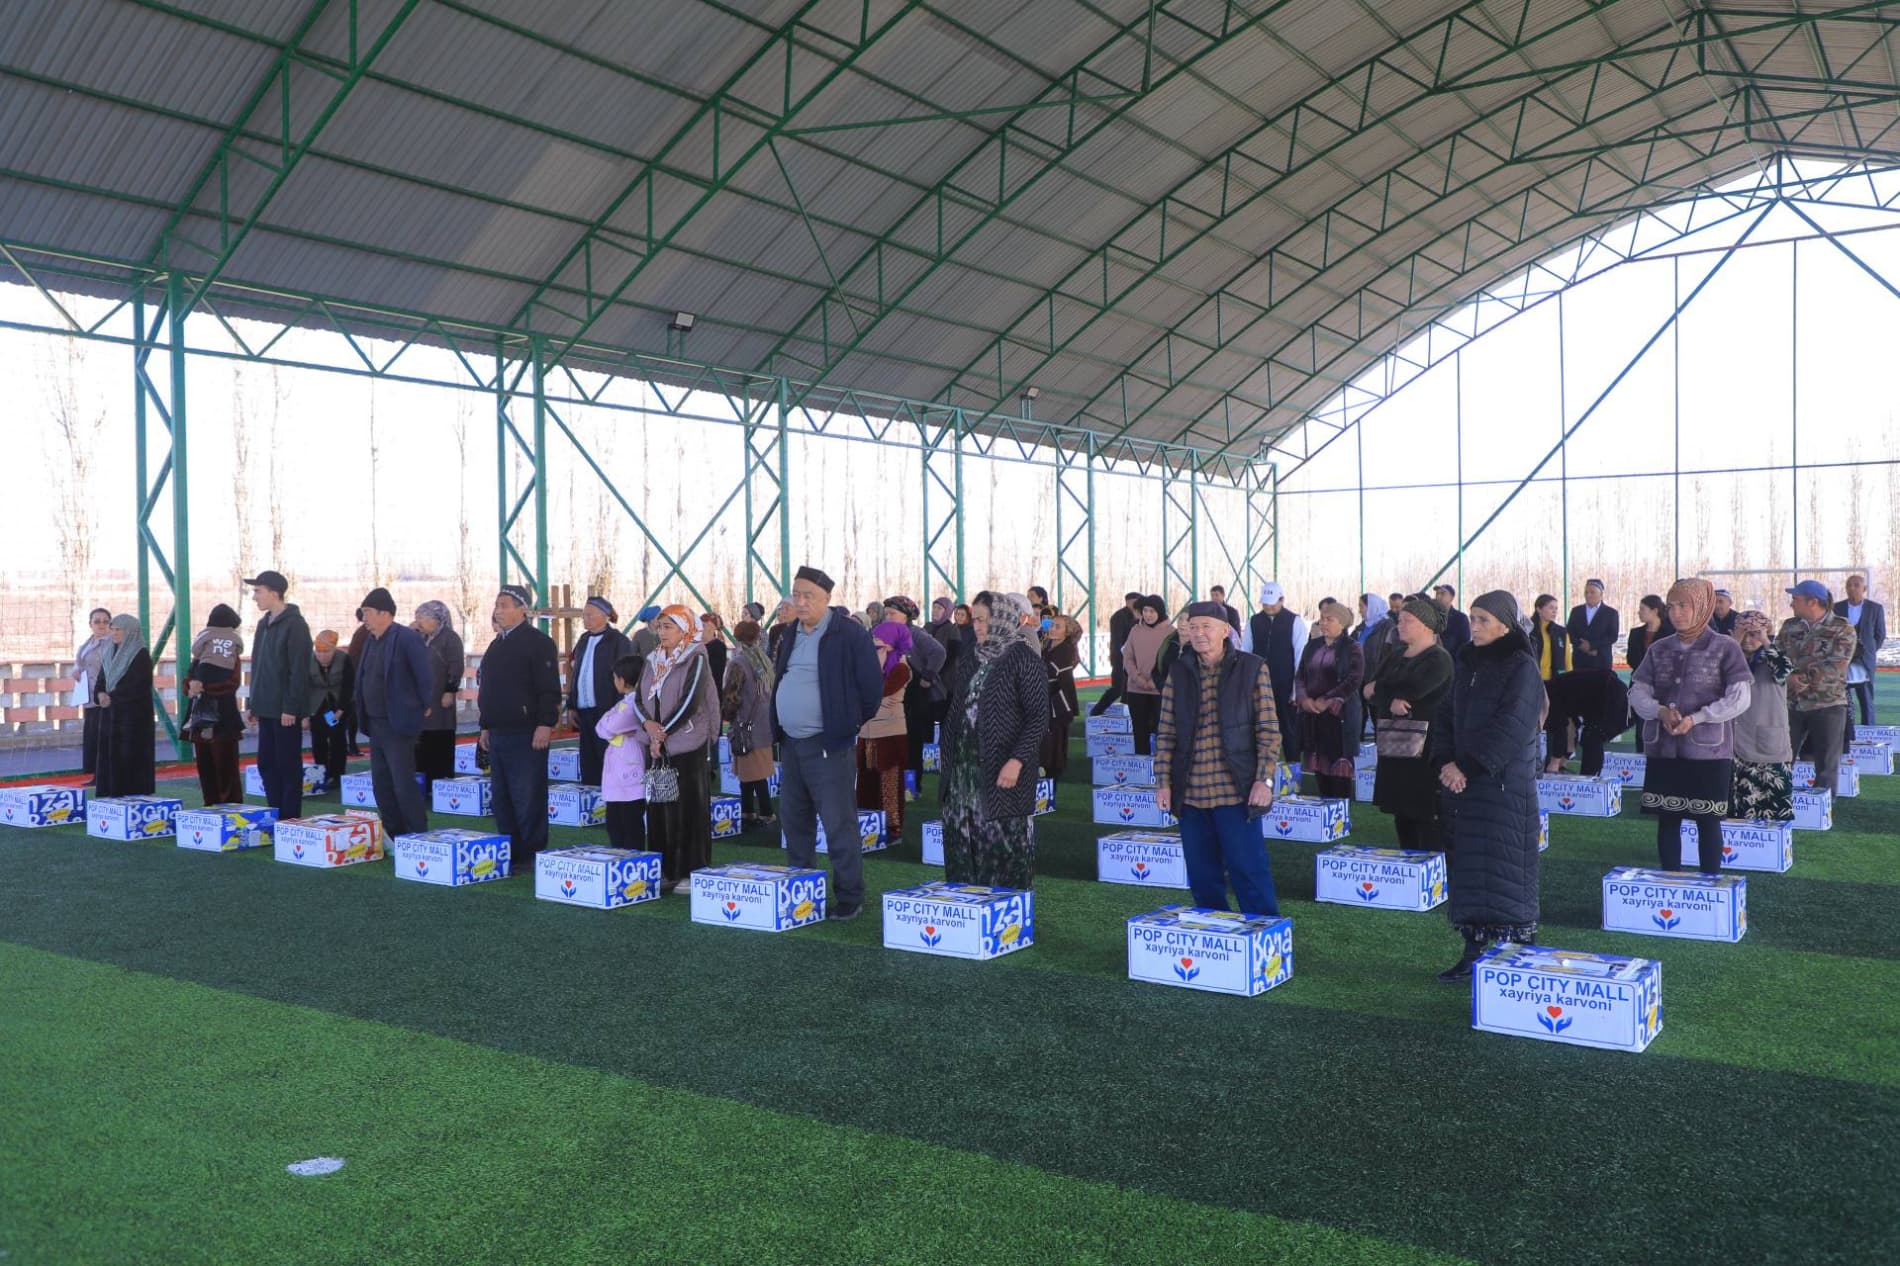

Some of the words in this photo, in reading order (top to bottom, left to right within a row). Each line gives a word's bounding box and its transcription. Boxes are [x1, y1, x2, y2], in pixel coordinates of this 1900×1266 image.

[1577, 786, 1602, 794] MALL
[1097, 792, 1113, 800] POP
[1135, 795, 1157, 804] MALL
[1294, 807, 1320, 817] MALL
[290, 828, 304, 838] CITY
[1741, 831, 1775, 842] MALL
[412, 843, 427, 853] CITY
[1103, 843, 1123, 852] POP
[1126, 844, 1149, 855] CITY
[1152, 847, 1181, 858] MALL
[539, 858, 556, 869] POP
[558, 860, 576, 872] CITY
[578, 863, 600, 876] MALL
[1322, 860, 1347, 870] POP
[1350, 862, 1378, 873] CITY
[1382, 866, 1416, 878] MALL
[1369, 873, 1405, 884] karvoni
[694, 878, 714, 889] POP
[717, 880, 740, 893] CITY
[742, 884, 771, 896] MALL
[1609, 884, 1640, 896] POP
[1644, 888, 1678, 900] CITY
[1683, 890, 1725, 904] MALL
[732, 893, 762, 904] karvoni
[1622, 898, 1664, 909] xayriya
[1668, 899, 1711, 911] karvoni
[887, 900, 910, 913] POP
[913, 904, 940, 917] CITY
[943, 907, 976, 921] MALL
[896, 914, 928, 926] xayriya
[930, 916, 966, 928] karvoni
[1134, 928, 1162, 942] POP
[1166, 932, 1198, 946] CITY
[1202, 936, 1242, 953] MALL
[1145, 943, 1185, 957] xayriya
[1188, 946, 1229, 962] karvoni
[1484, 970, 1522, 987] POP
[1528, 976, 1570, 993] CITY
[1576, 982, 1630, 1002] MALL
[1499, 987, 1551, 1004] xayriya
[1556, 994, 1612, 1011] karvoni
